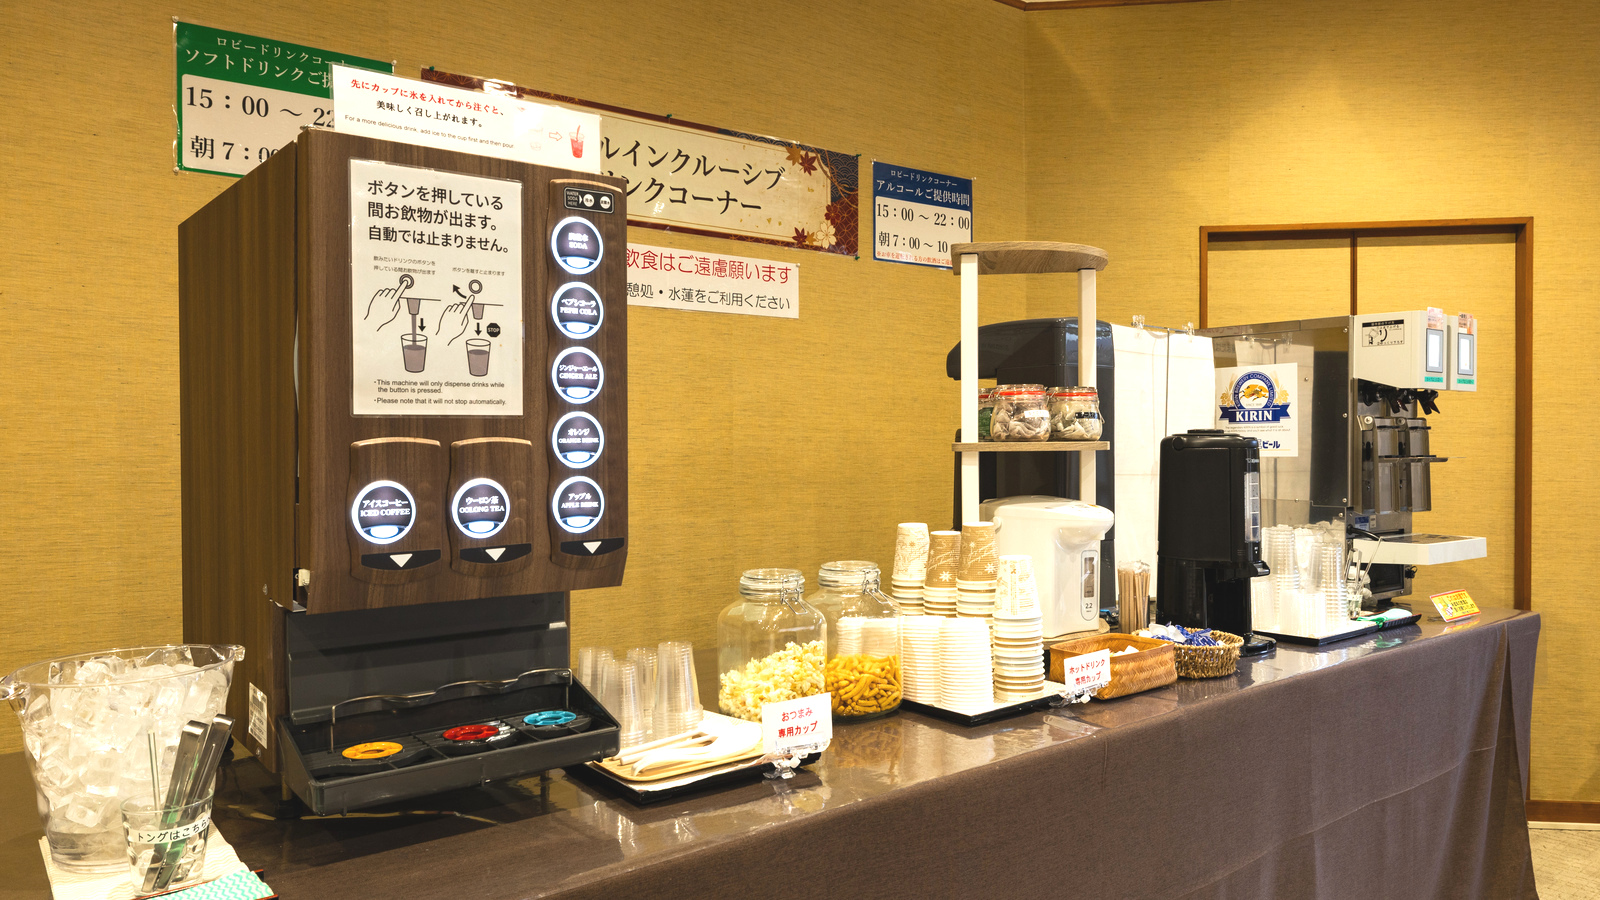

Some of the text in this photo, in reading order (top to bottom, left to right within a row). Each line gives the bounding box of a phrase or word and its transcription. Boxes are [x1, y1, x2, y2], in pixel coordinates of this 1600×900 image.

[351, 79, 504, 116] 先にカップに氷を入れてから注ぐと、
[376, 100, 483, 128] 美味しく召し上がれます。
[378, 121, 402, 130] delicious
[890, 170, 958, 187] ロビードリンクコーナー
[367, 180, 503, 211] ボタンを押している
[601, 170, 762, 215] ンクコーナー
[876, 179, 970, 207] アルコールご提供時間
[368, 202, 497, 232] 間お飲物が出ます。
[368, 225, 508, 254] 自動では止まりません。
[569, 242, 588, 250] SODA
[626, 248, 792, 284] 飲食はご遠慮願います
[579, 308, 598, 316] COLA
[1236, 410, 1272, 422] KIRIN
[568, 428, 590, 436] オレンジ
[362, 498, 408, 508] アイスコーヒー
[465, 496, 499, 506] ウーロン茶
[568, 492, 592, 500] アップル
[380, 508, 410, 516] COFFEE
[459, 506, 489, 514] OOLONG
[1069, 658, 1105, 674] ホットドリンク
[1075, 671, 1101, 685] 専用カップ
[781, 707, 813, 722] おつまみ
[778, 720, 818, 738] 専用カップ
[138, 816, 210, 843] トングはこちら
